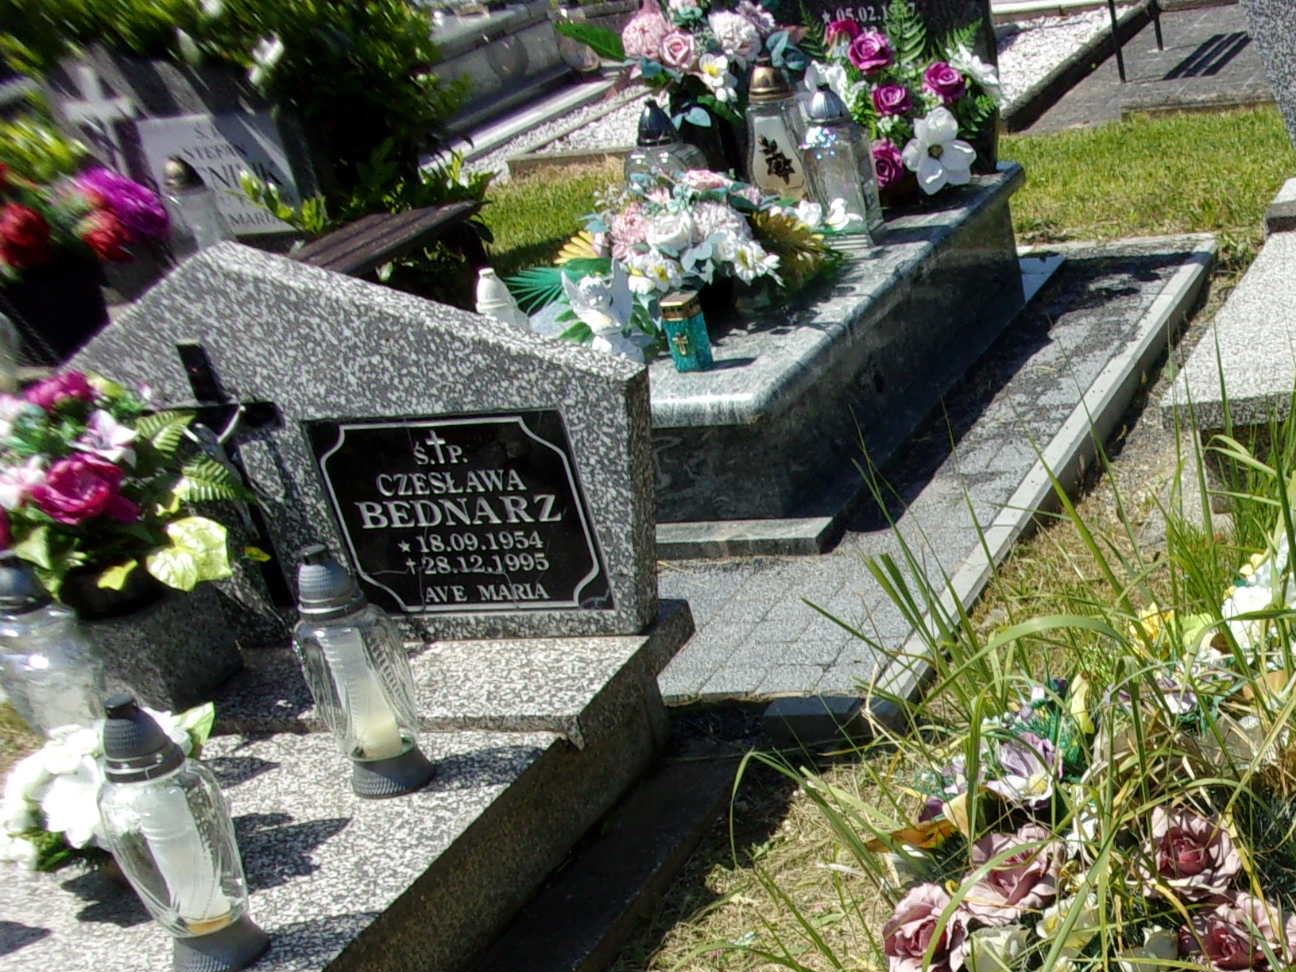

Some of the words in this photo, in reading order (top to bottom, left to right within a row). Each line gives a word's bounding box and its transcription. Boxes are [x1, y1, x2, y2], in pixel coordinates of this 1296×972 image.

[836, 3, 916, 22] 05.02.17
[376, 468, 527, 497] CZESŁAWA
[354, 494, 562, 529] BEDNARZ
[416, 531, 543, 553] 18.09.1954
[421, 553, 549, 575] 28.12.1995
[425, 585, 468, 603] AVE
[479, 582, 551, 601] MARIA
